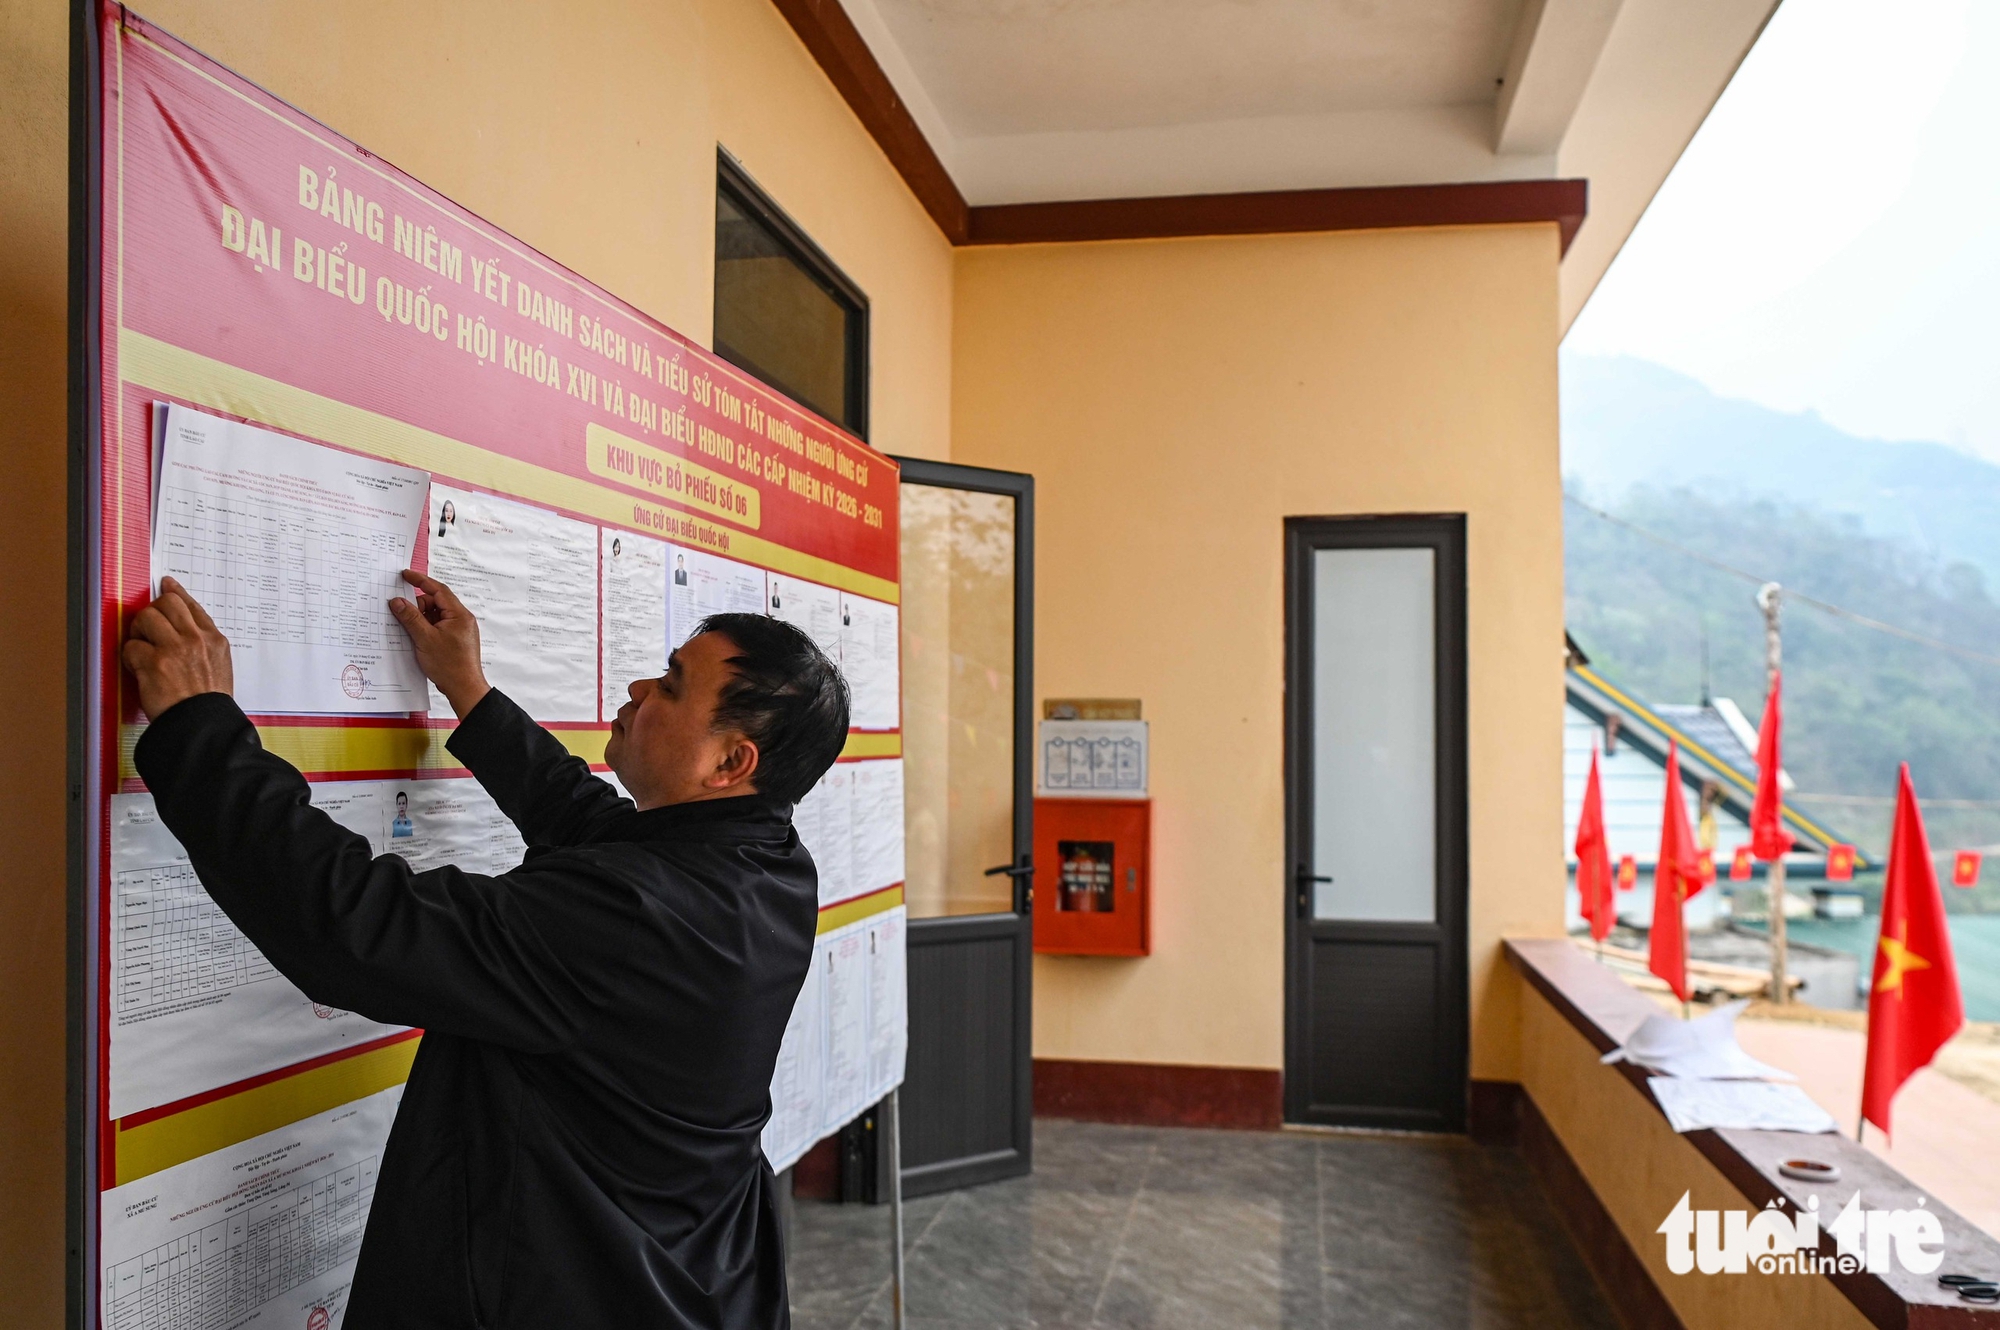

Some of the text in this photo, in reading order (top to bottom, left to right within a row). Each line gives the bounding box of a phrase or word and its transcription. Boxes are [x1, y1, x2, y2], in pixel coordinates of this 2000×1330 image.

[221, 203, 281, 273] ĐẠI
[294, 237, 366, 305] BIỂU
[376, 277, 448, 341] QUỐC
[457, 313, 497, 367] HỘI
[504, 335, 561, 391] KHÓA
[567, 362, 597, 406] XVI
[602, 379, 625, 418] VÀ
[629, 392, 657, 434] ĐẠI
[661, 405, 695, 447] BIỂU
[699, 424, 734, 464] HĐND
[736, 442, 761, 476] CÁC
[764, 453, 786, 486] CẤP
[788, 467, 821, 503] NHIỆM
[822, 481, 835, 508] KỲ
[836, 490, 858, 519] 2026
[864, 503, 883, 529] 2031
[299, 164, 868, 487] BẢNG NIÊM YẾT DANH SÁCH VÀ TIỂU SỬ TÓM TẮT NHỮNG NGƯỜI ỨNG CỬ
[607, 443, 747, 516] KHU VỰC BỎ PHIẾU SỐ 06
[633, 503, 730, 553] ỨNG CỬ ĐẠI BIỂU QUỐC HỘI
